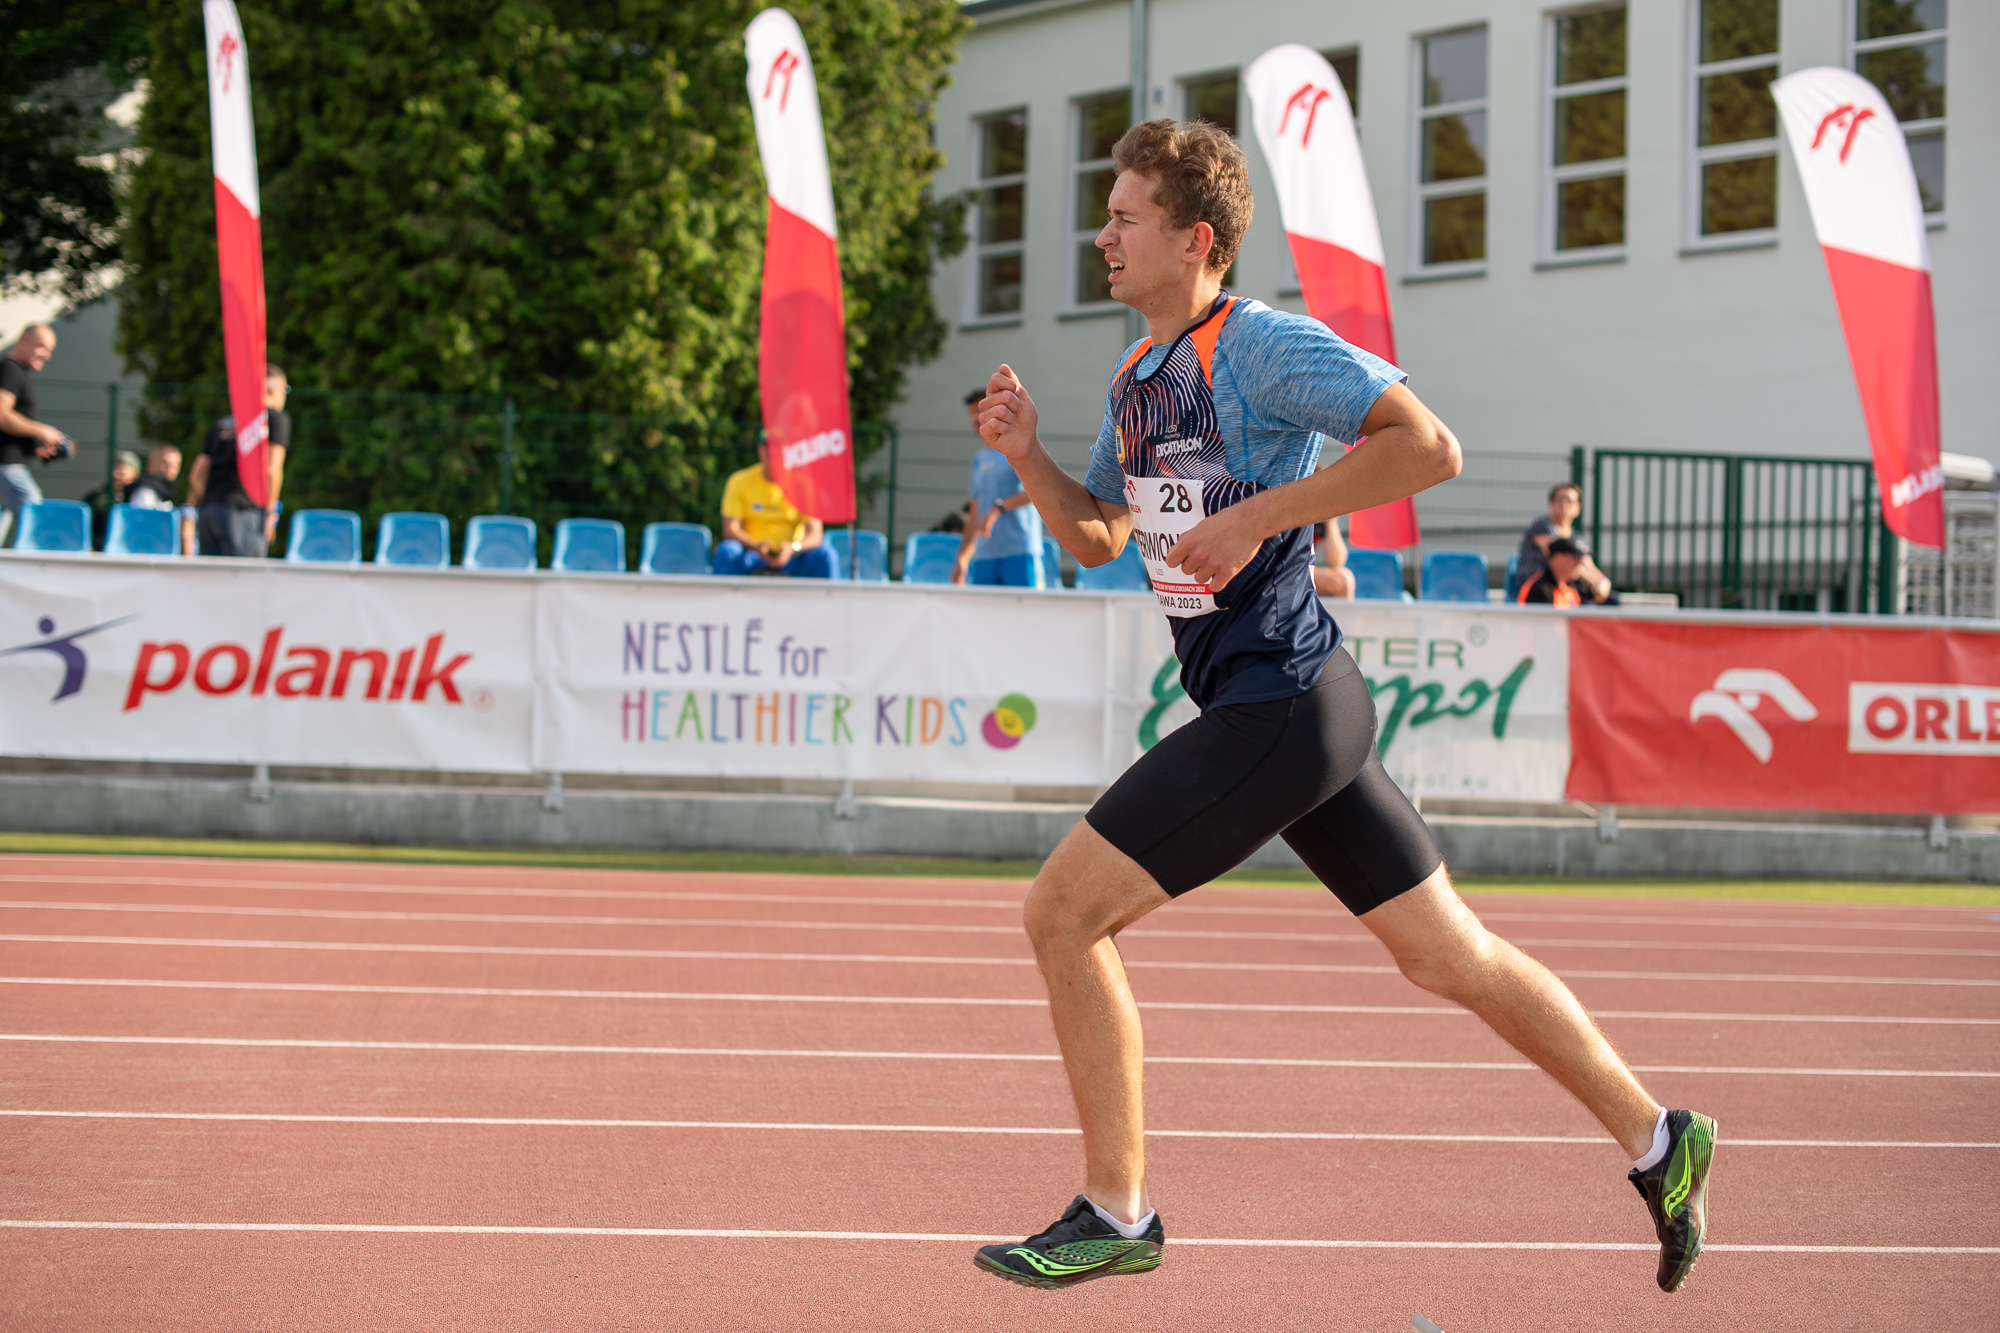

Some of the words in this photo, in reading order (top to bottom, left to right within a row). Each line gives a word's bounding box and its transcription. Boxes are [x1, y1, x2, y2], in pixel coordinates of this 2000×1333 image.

[1156, 436, 1203, 457] DECATHLON
[1159, 482, 1193, 513] 28
[1177, 597, 1203, 610] 2023
[121, 624, 475, 714] polanik
[622, 618, 764, 676] NESTLÉ
[777, 636, 828, 677] for
[622, 689, 854, 746] HEALTHIER
[876, 694, 968, 747] KIDS
